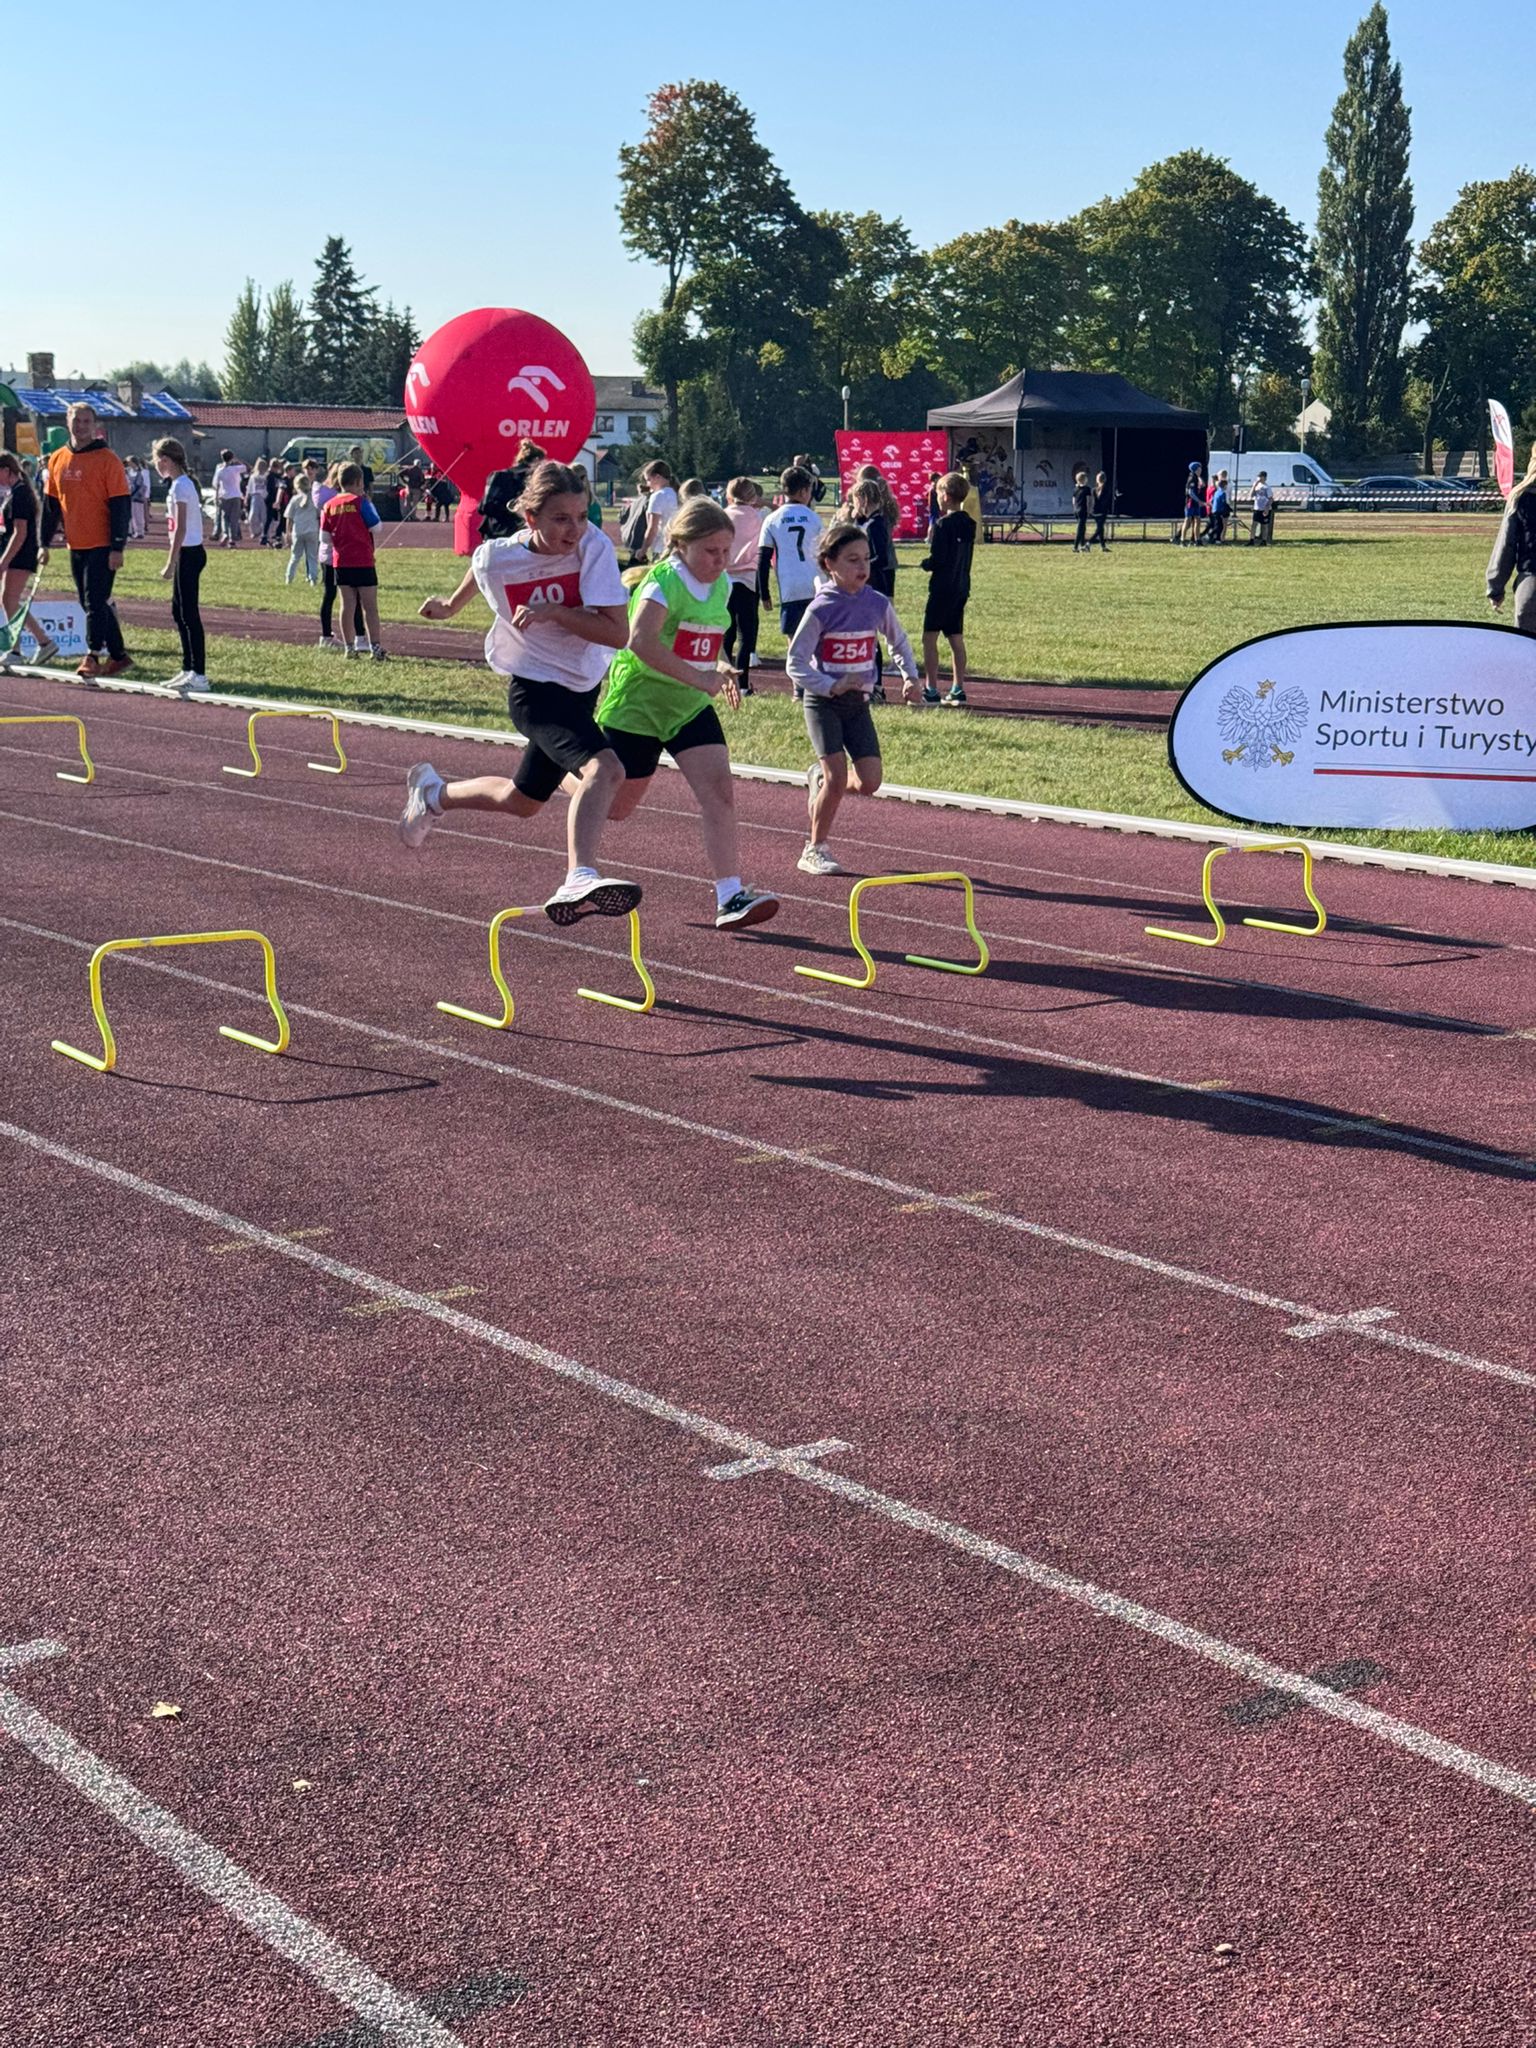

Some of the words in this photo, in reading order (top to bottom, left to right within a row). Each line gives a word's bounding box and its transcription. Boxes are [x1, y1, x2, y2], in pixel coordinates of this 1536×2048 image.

[498, 418, 571, 438] ORLEN
[787, 525, 806, 562] 7
[528, 583, 565, 606] 40
[690, 638, 711, 657] 19
[831, 641, 868, 660] 254
[1319, 689, 1505, 716] Ministerstwo
[1314, 722, 1408, 751] Sportu
[1418, 724, 1425, 748] i
[1434, 725, 1536, 757] Turysty
